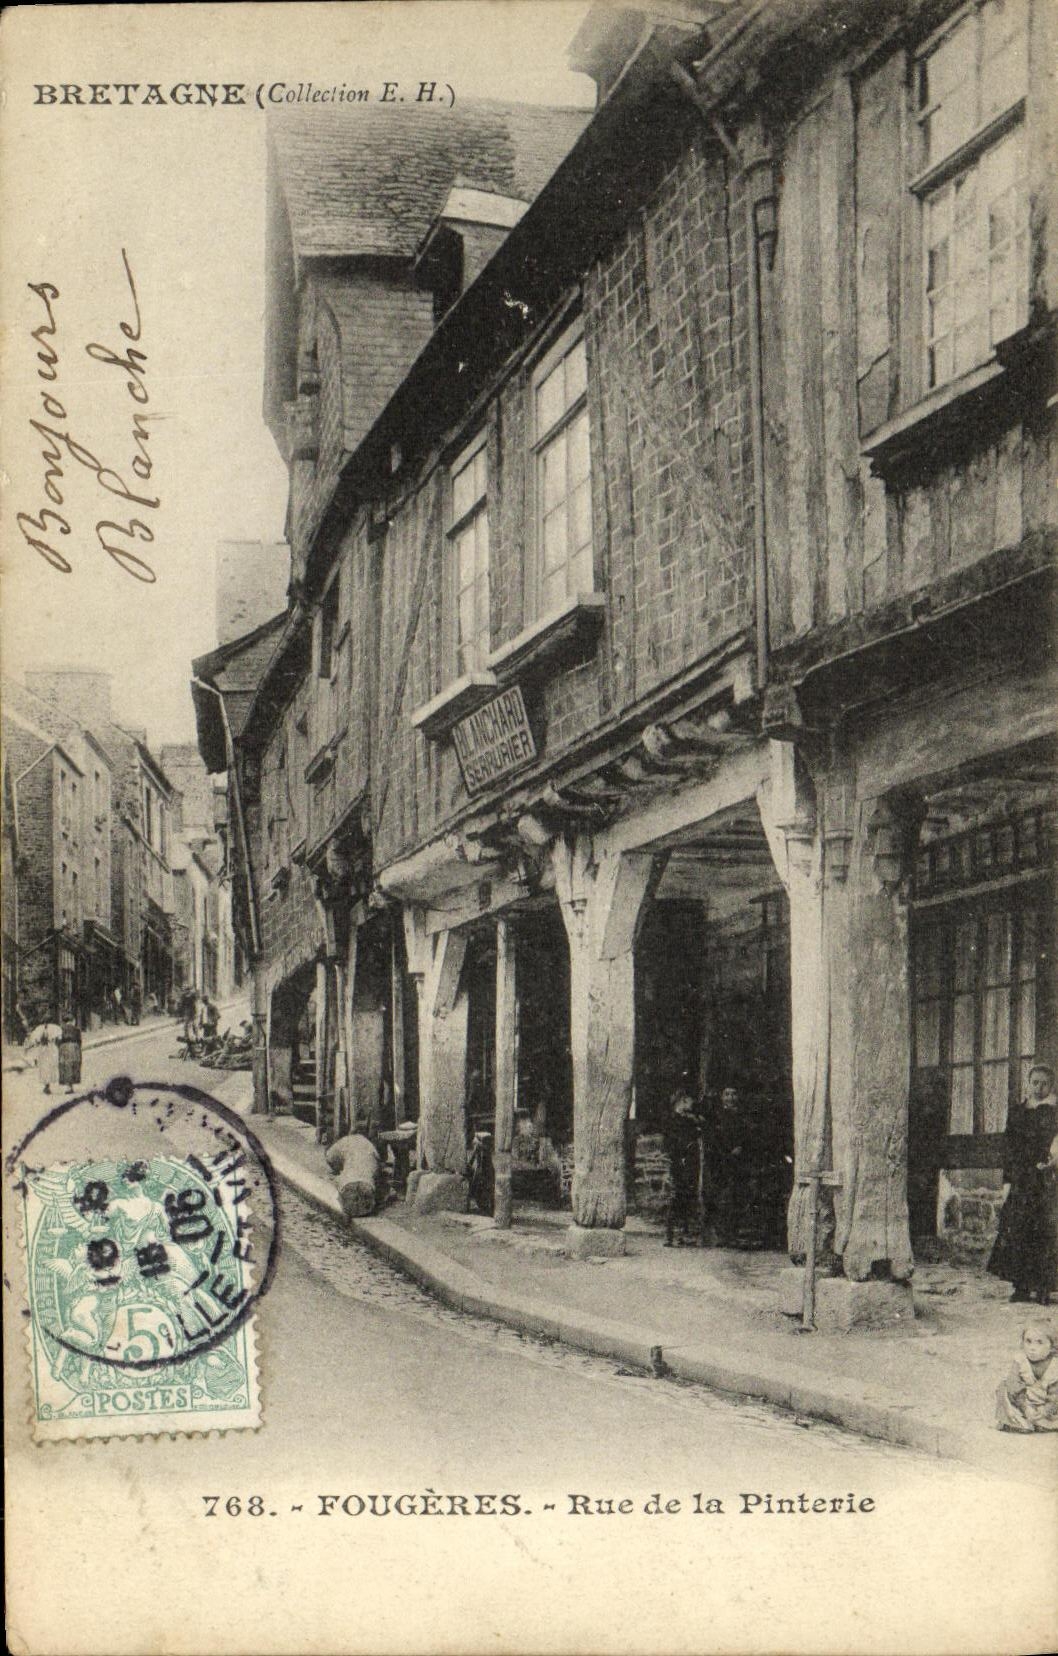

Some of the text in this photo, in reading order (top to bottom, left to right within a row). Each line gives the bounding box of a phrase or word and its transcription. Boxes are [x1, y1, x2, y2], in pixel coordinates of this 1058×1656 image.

[86, 248, 160, 584] Blanche
[464, 727, 532, 788] SERRURIER
[98, 1388, 189, 1414] POSTES
